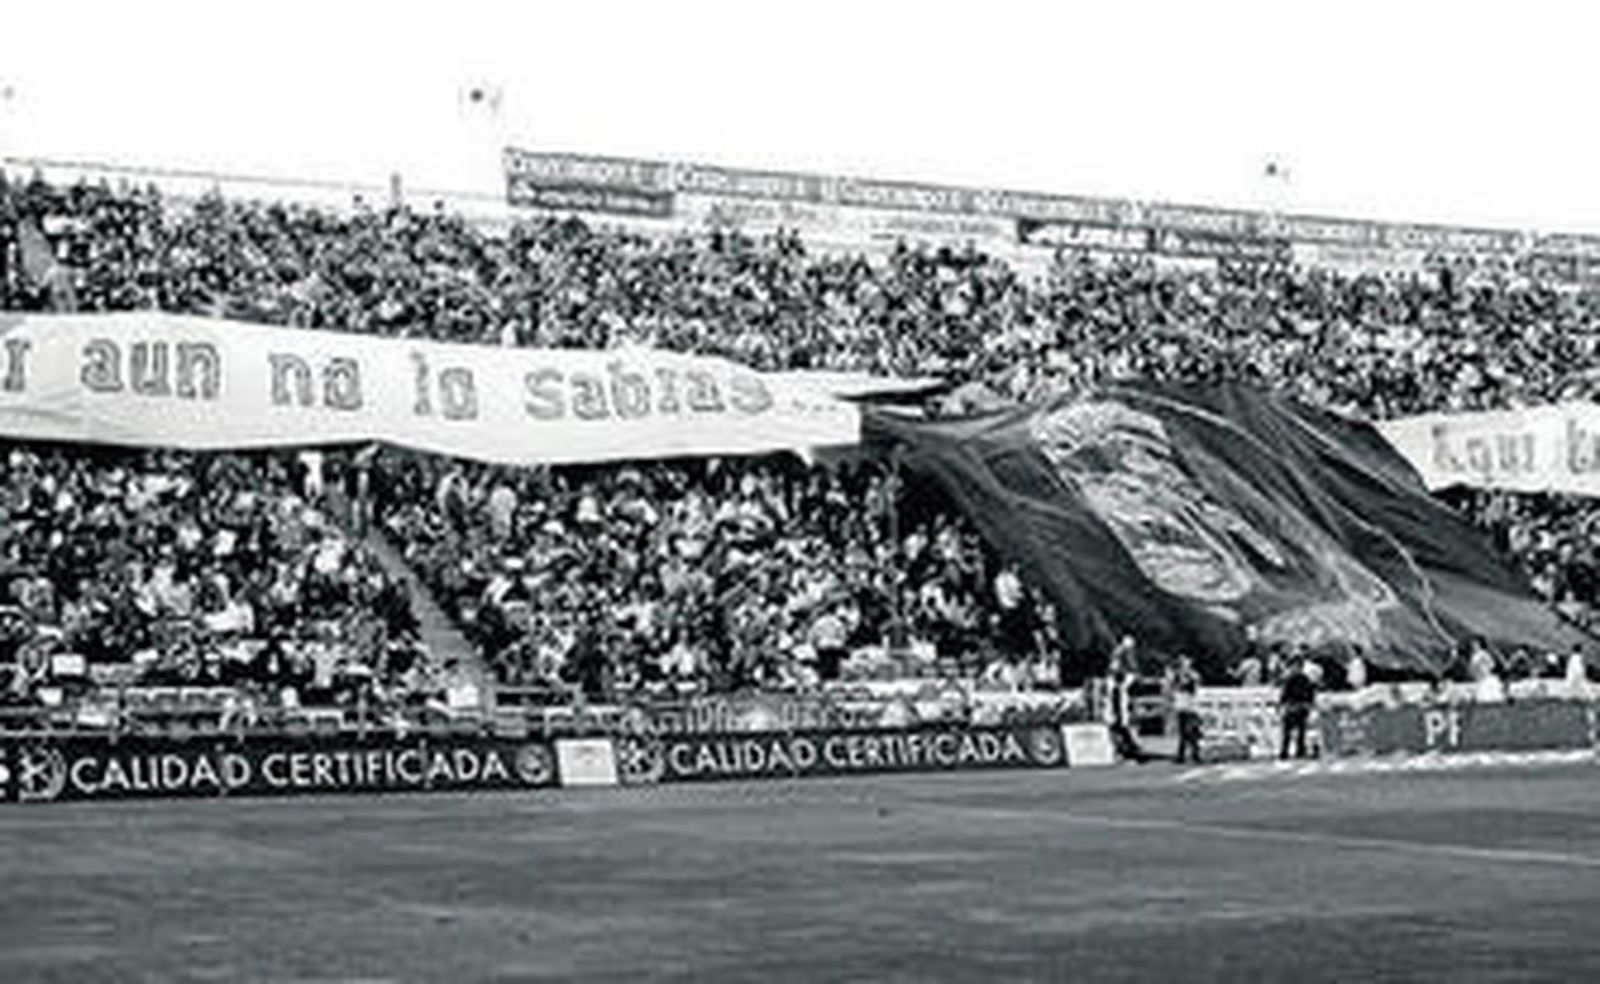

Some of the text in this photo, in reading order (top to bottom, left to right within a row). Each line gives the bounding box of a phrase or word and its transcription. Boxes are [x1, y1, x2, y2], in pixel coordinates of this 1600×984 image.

[71, 748, 509, 792] CALIDAD CERTIFICADA
[670, 731, 1024, 775] CALIDAD CERTIFICADA
